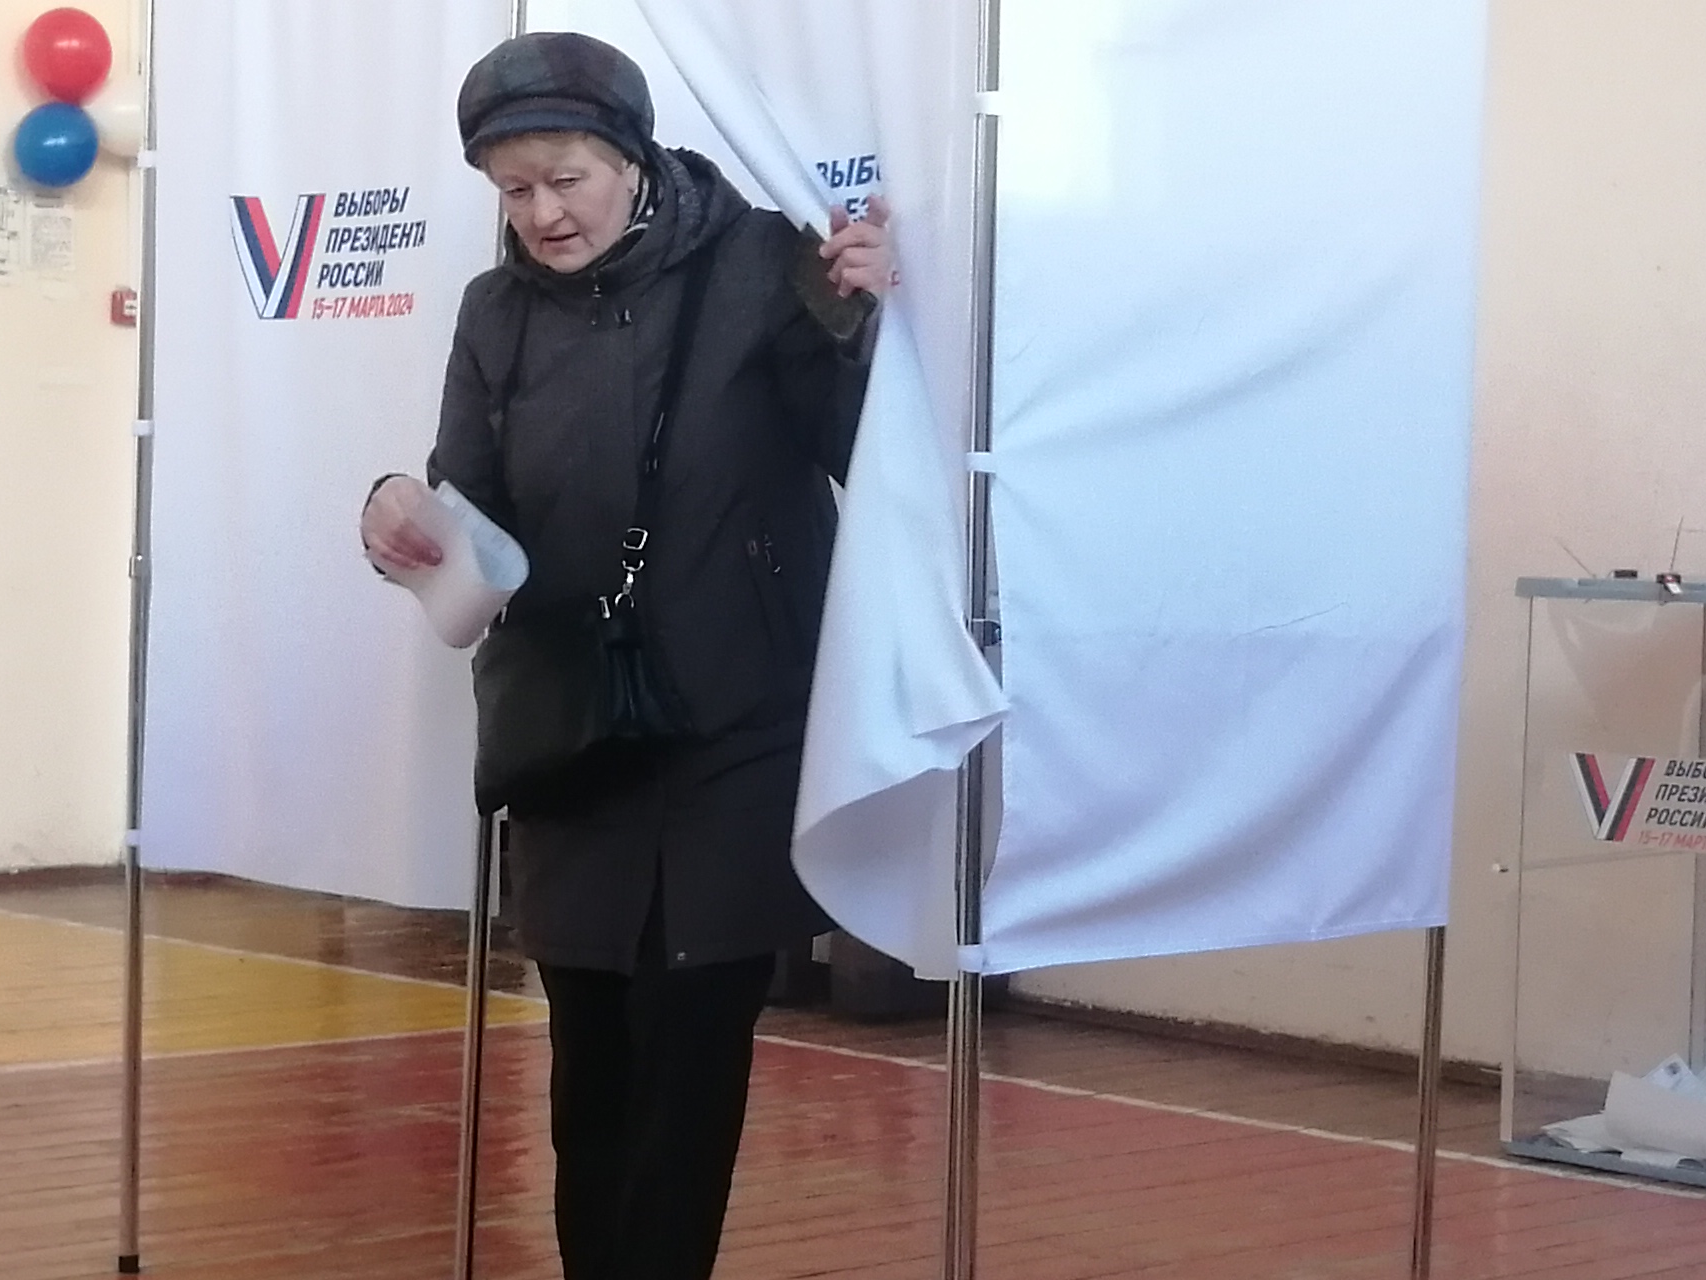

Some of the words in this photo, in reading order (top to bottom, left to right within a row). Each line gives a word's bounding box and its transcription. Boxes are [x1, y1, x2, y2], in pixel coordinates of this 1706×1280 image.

[333, 186, 410, 218] ВЫБОРЫ
[325, 220, 428, 255] ПРЕЗИДЕНТА
[317, 260, 385, 289] РОССИИ
[346, 294, 385, 318] МАРТА
[385, 292, 414, 316] 2024
